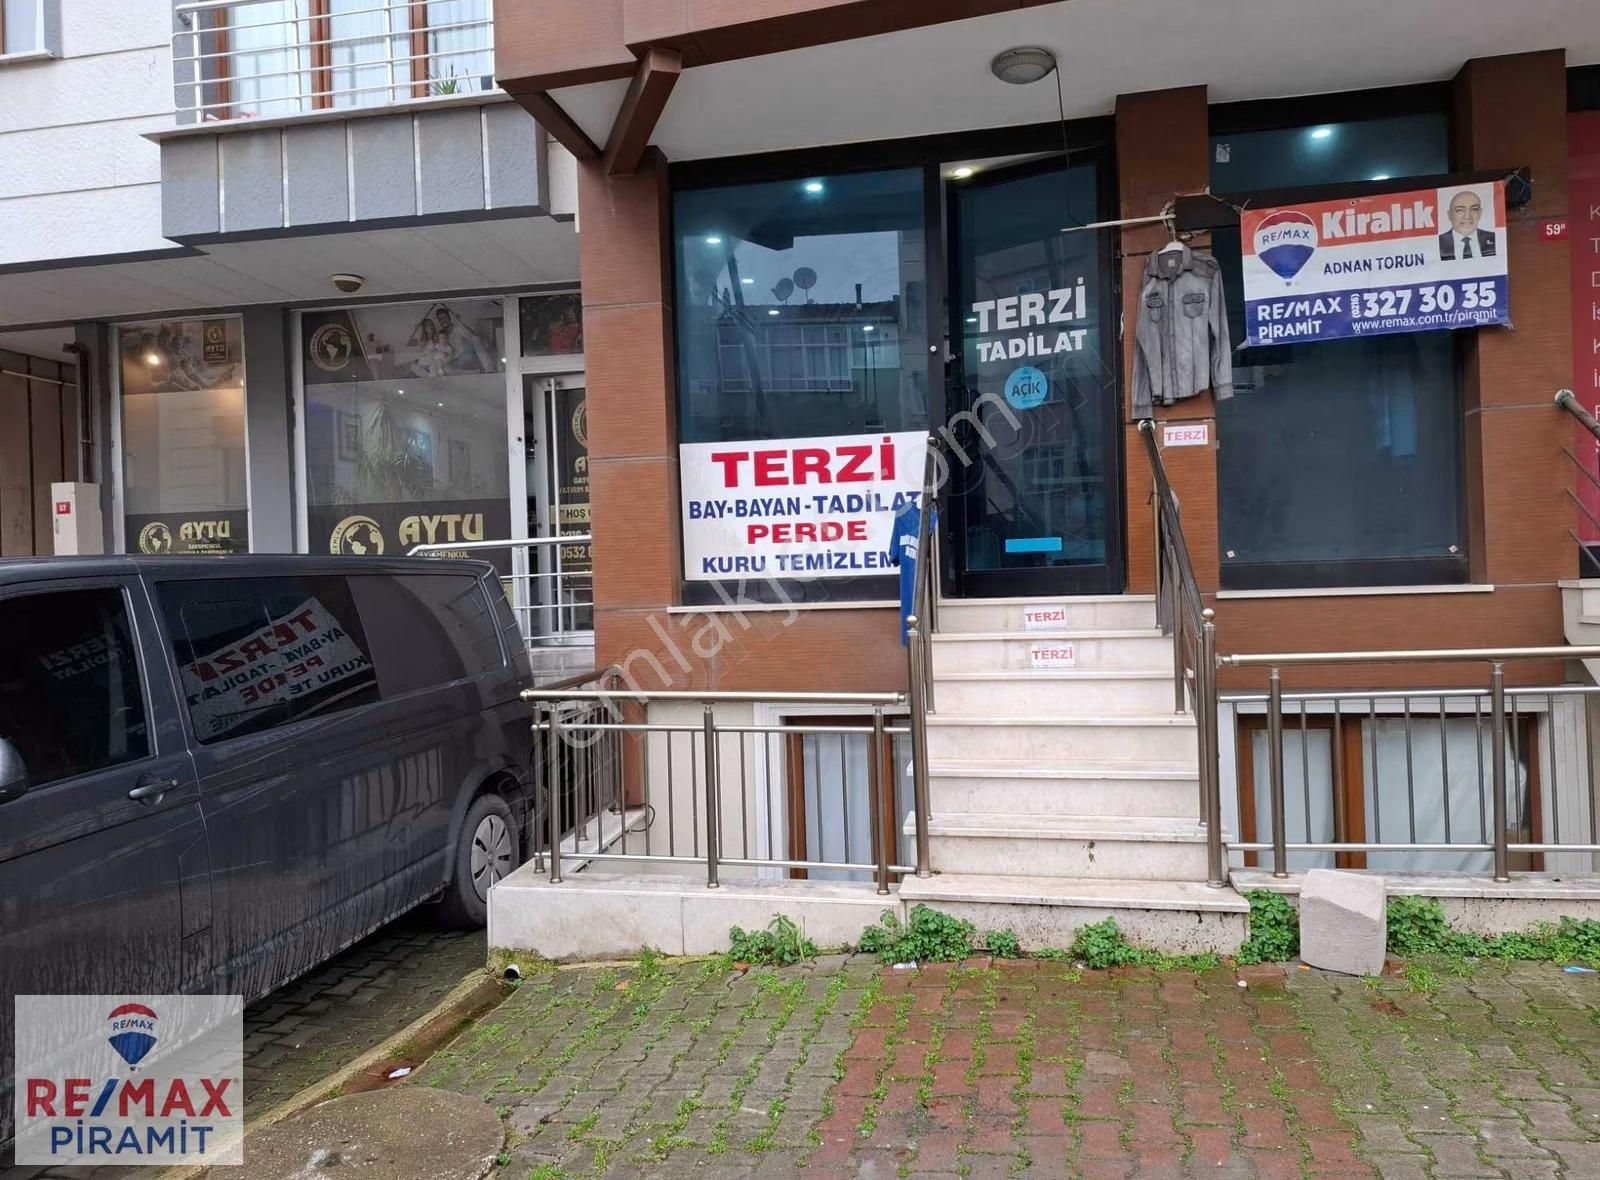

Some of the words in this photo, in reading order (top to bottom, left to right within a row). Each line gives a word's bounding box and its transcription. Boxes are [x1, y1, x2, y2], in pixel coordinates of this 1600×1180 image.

[1322, 201, 1435, 240] Kiralık
[1262, 229, 1311, 245] RE/MAX
[1323, 258, 1373, 276] ADNAN
[1375, 253, 1425, 271] TORUN
[972, 277, 1087, 333] TERZİ
[1257, 297, 1342, 321] RE/MAX
[1362, 289, 1413, 318] 327
[1418, 284, 1456, 313] 30
[1461, 281, 1497, 309] 35
[1258, 319, 1323, 339] PİRAMİT
[1351, 308, 1498, 332] www.remax.com.tr/piramit
[976, 329, 1088, 363] TADİLAT
[1011, 381, 1041, 398] AÇIK
[1165, 427, 1206, 441] TERZİ
[711, 436, 896, 488] TERZİ
[180, 520, 230, 541] AYTU
[399, 513, 484, 546] AYTU
[747, 520, 868, 545] PERDE
[702, 555, 766, 575] KURU
[776, 549, 898, 572] TEMİZLEM
[1025, 609, 1065, 622] TERZİ
[1032, 647, 1073, 660] TERZİ
